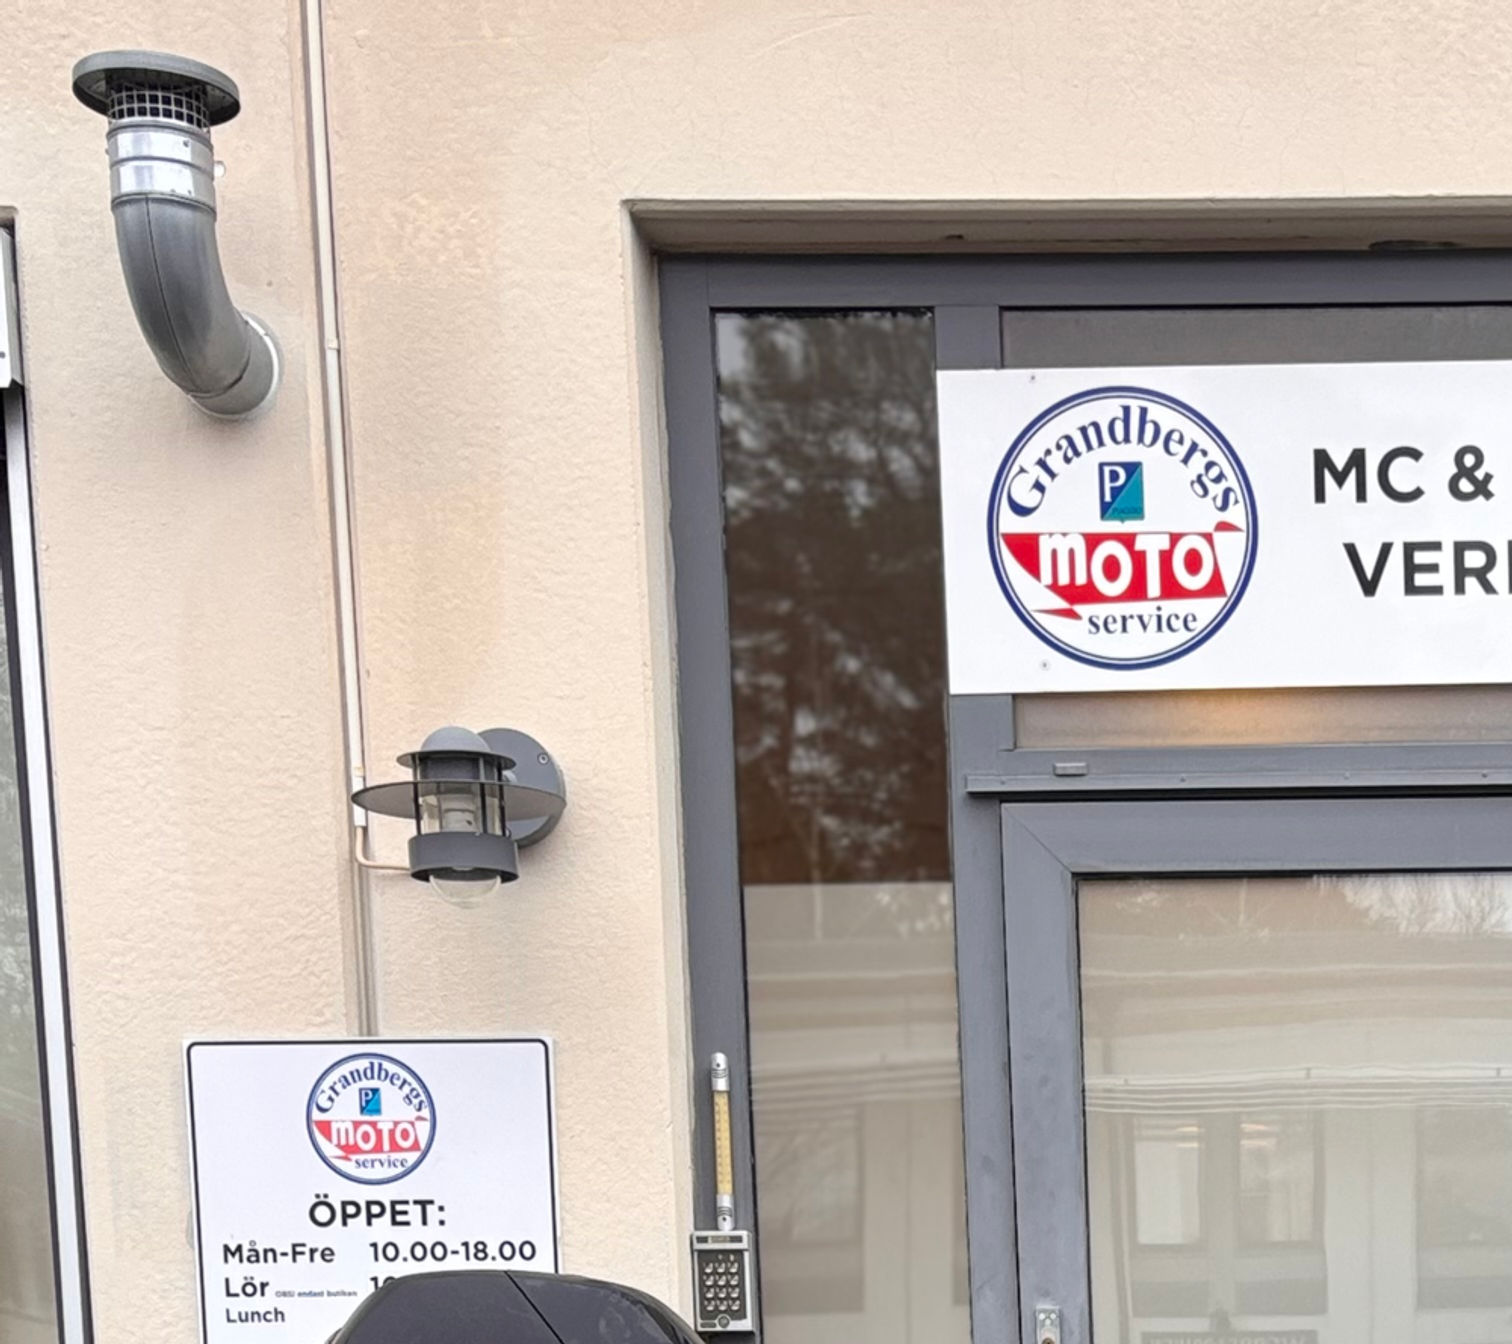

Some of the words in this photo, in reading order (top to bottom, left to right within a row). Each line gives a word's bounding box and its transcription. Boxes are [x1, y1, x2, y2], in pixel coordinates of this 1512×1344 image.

[1006, 403, 1241, 518] Grandbergs
[1313, 445, 1425, 505] MC
[1447, 443, 1496, 503] &
[1087, 604, 1199, 635] service
[315, 1061, 428, 1115] Grandbergs
[353, 1154, 409, 1169] service
[307, 1193, 447, 1228] ÖPPET:
[221, 1239, 337, 1265] Mån-Fre
[369, 1239, 538, 1264] 10.00-18.00
[223, 1276, 270, 1299] Lör
[225, 1306, 286, 1324] Lunch
